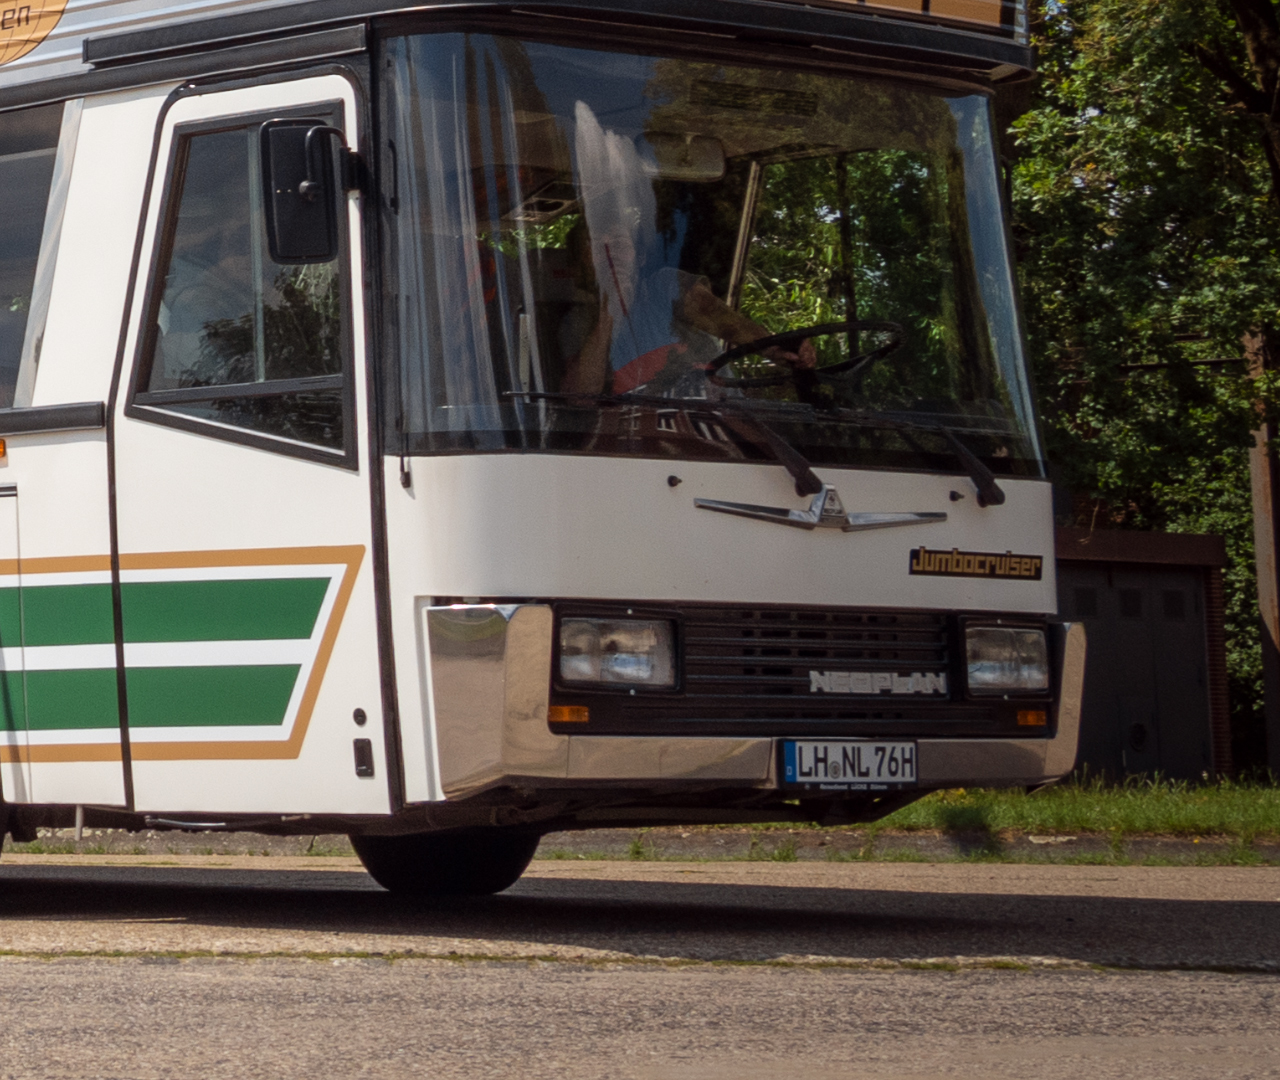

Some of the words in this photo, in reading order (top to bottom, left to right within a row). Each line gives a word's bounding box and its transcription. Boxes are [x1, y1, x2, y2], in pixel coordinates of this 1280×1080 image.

[911, 547, 1041, 576] Jumbocruiser
[809, 670, 947, 694] NEOPLAN
[798, 745, 828, 777] LH
[842, 745, 870, 777] NL
[874, 745, 914, 777] 76H
